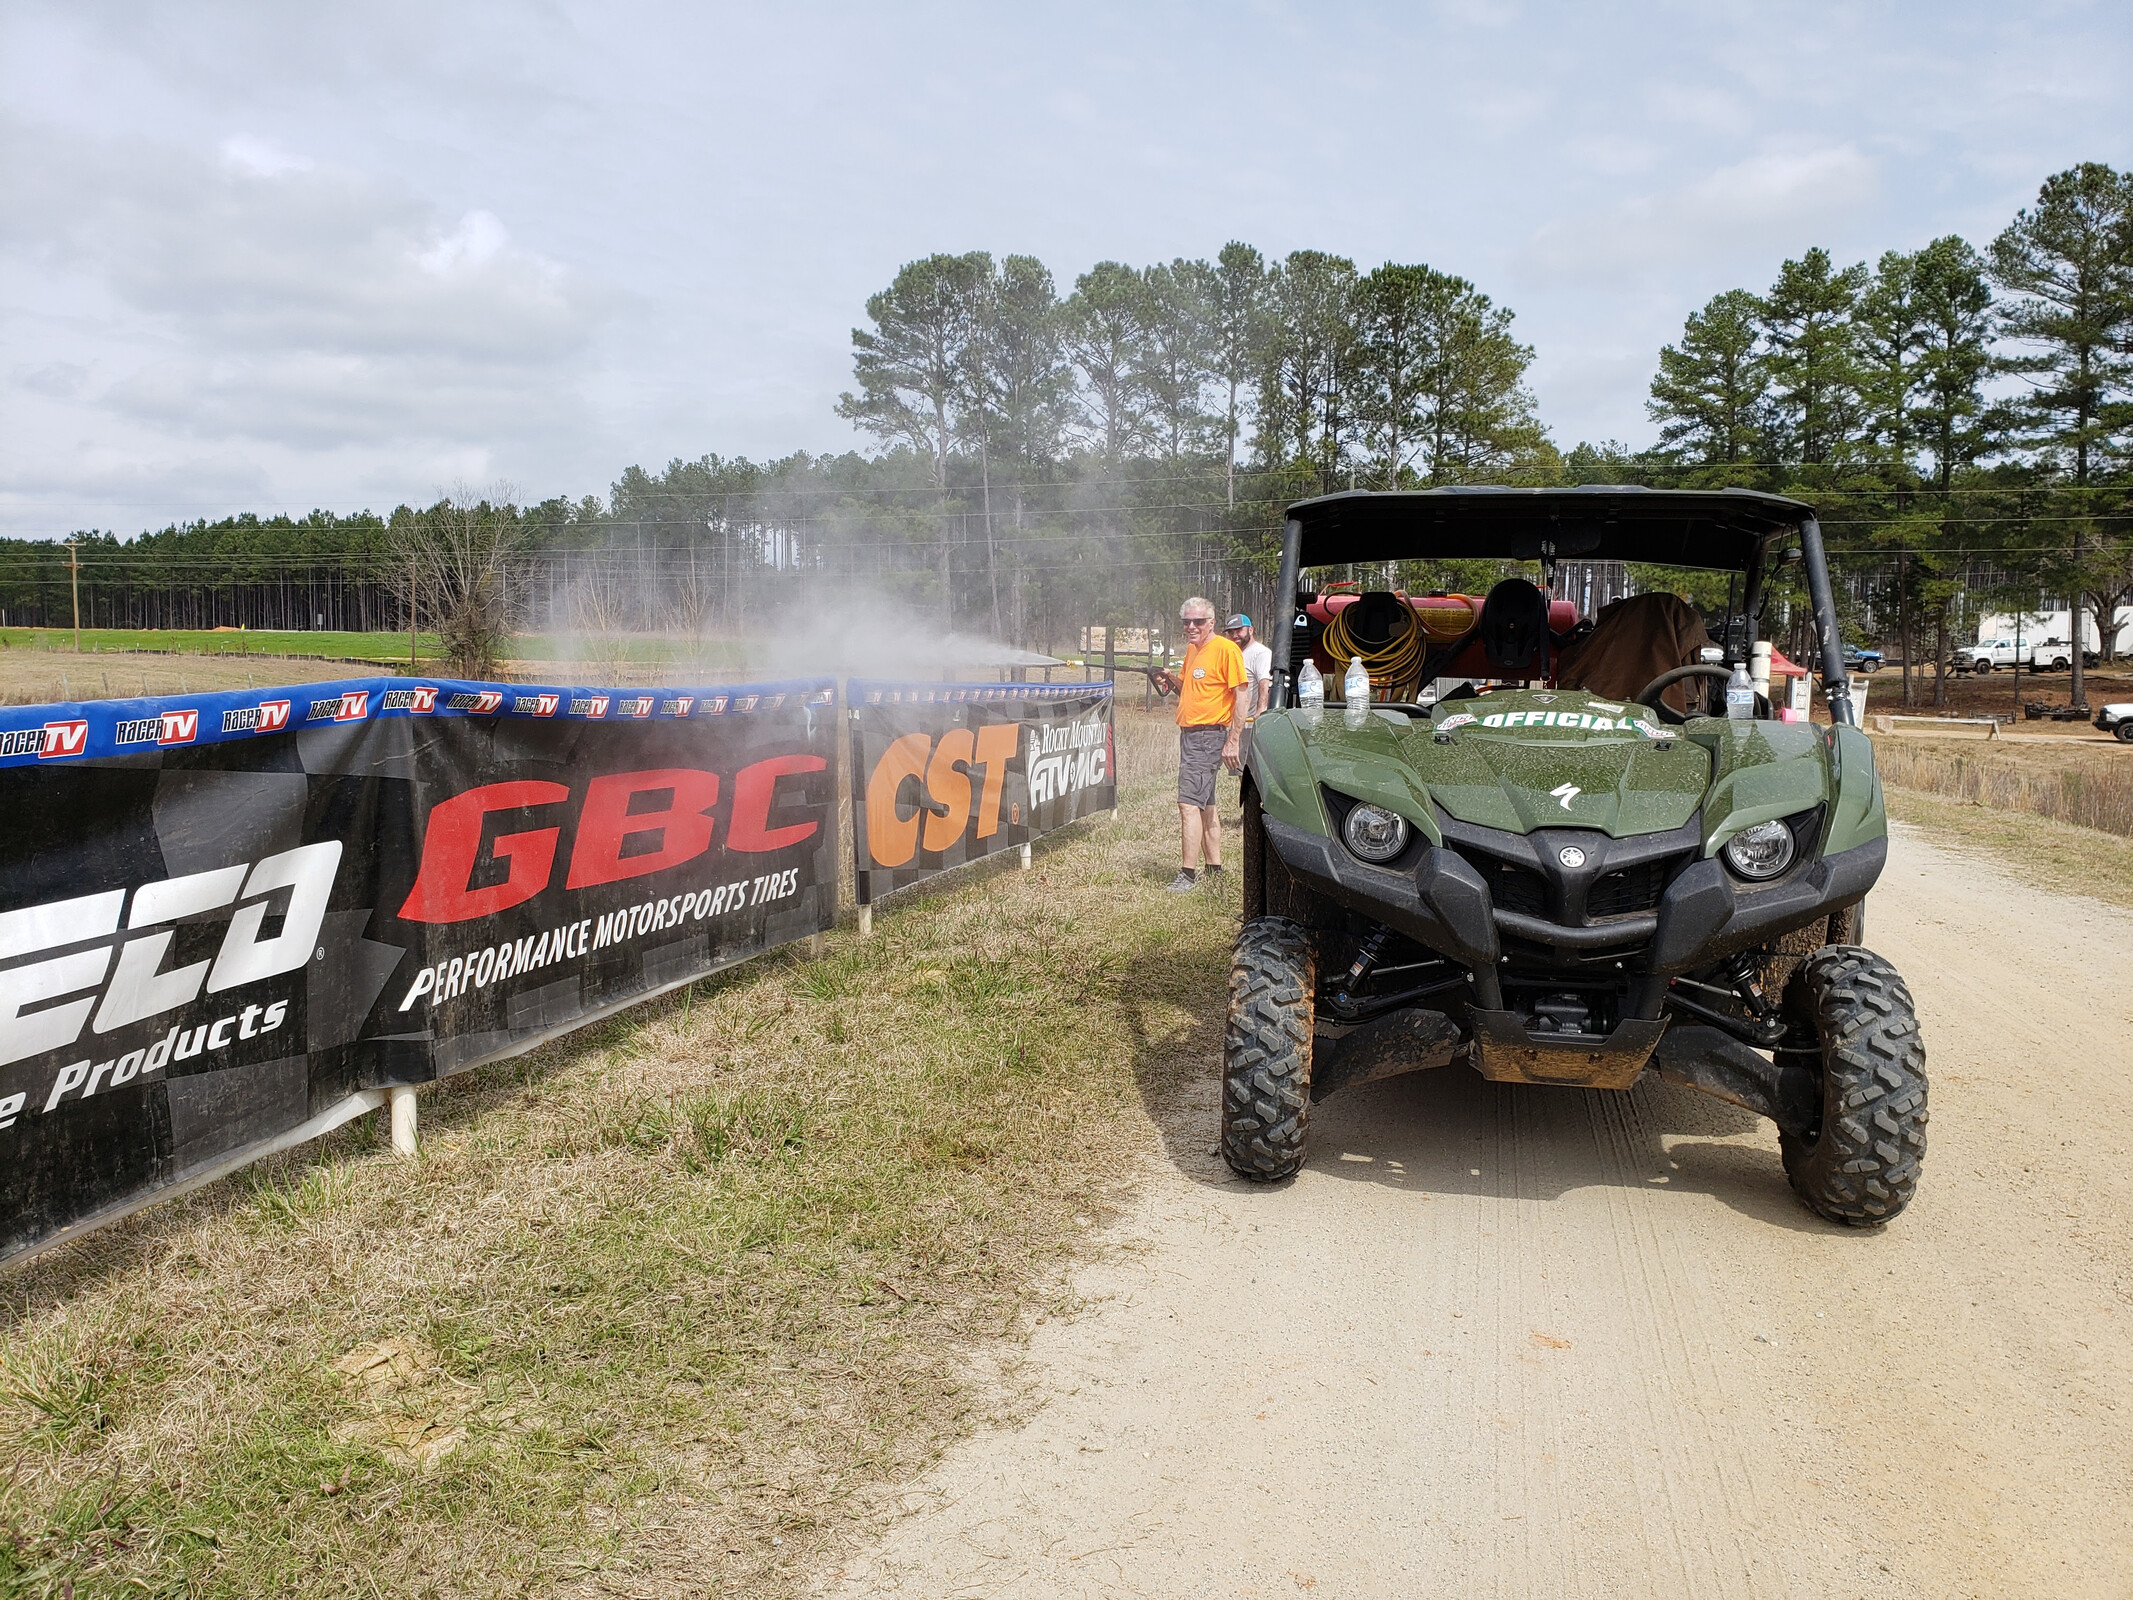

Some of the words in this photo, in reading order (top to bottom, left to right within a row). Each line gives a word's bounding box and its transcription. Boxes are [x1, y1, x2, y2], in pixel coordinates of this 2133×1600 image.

[1041, 723, 1071, 755] ROCKY
[1481, 711, 1633, 730] OFFICIAL
[397, 754, 827, 923] GBC
[867, 723, 1020, 868] CST
[398, 918, 592, 1012] PERFORMANCE
[592, 880, 749, 947] MOTORSPORTS
[749, 867, 799, 906] TIRES
[42, 1000, 289, 1113] Products
